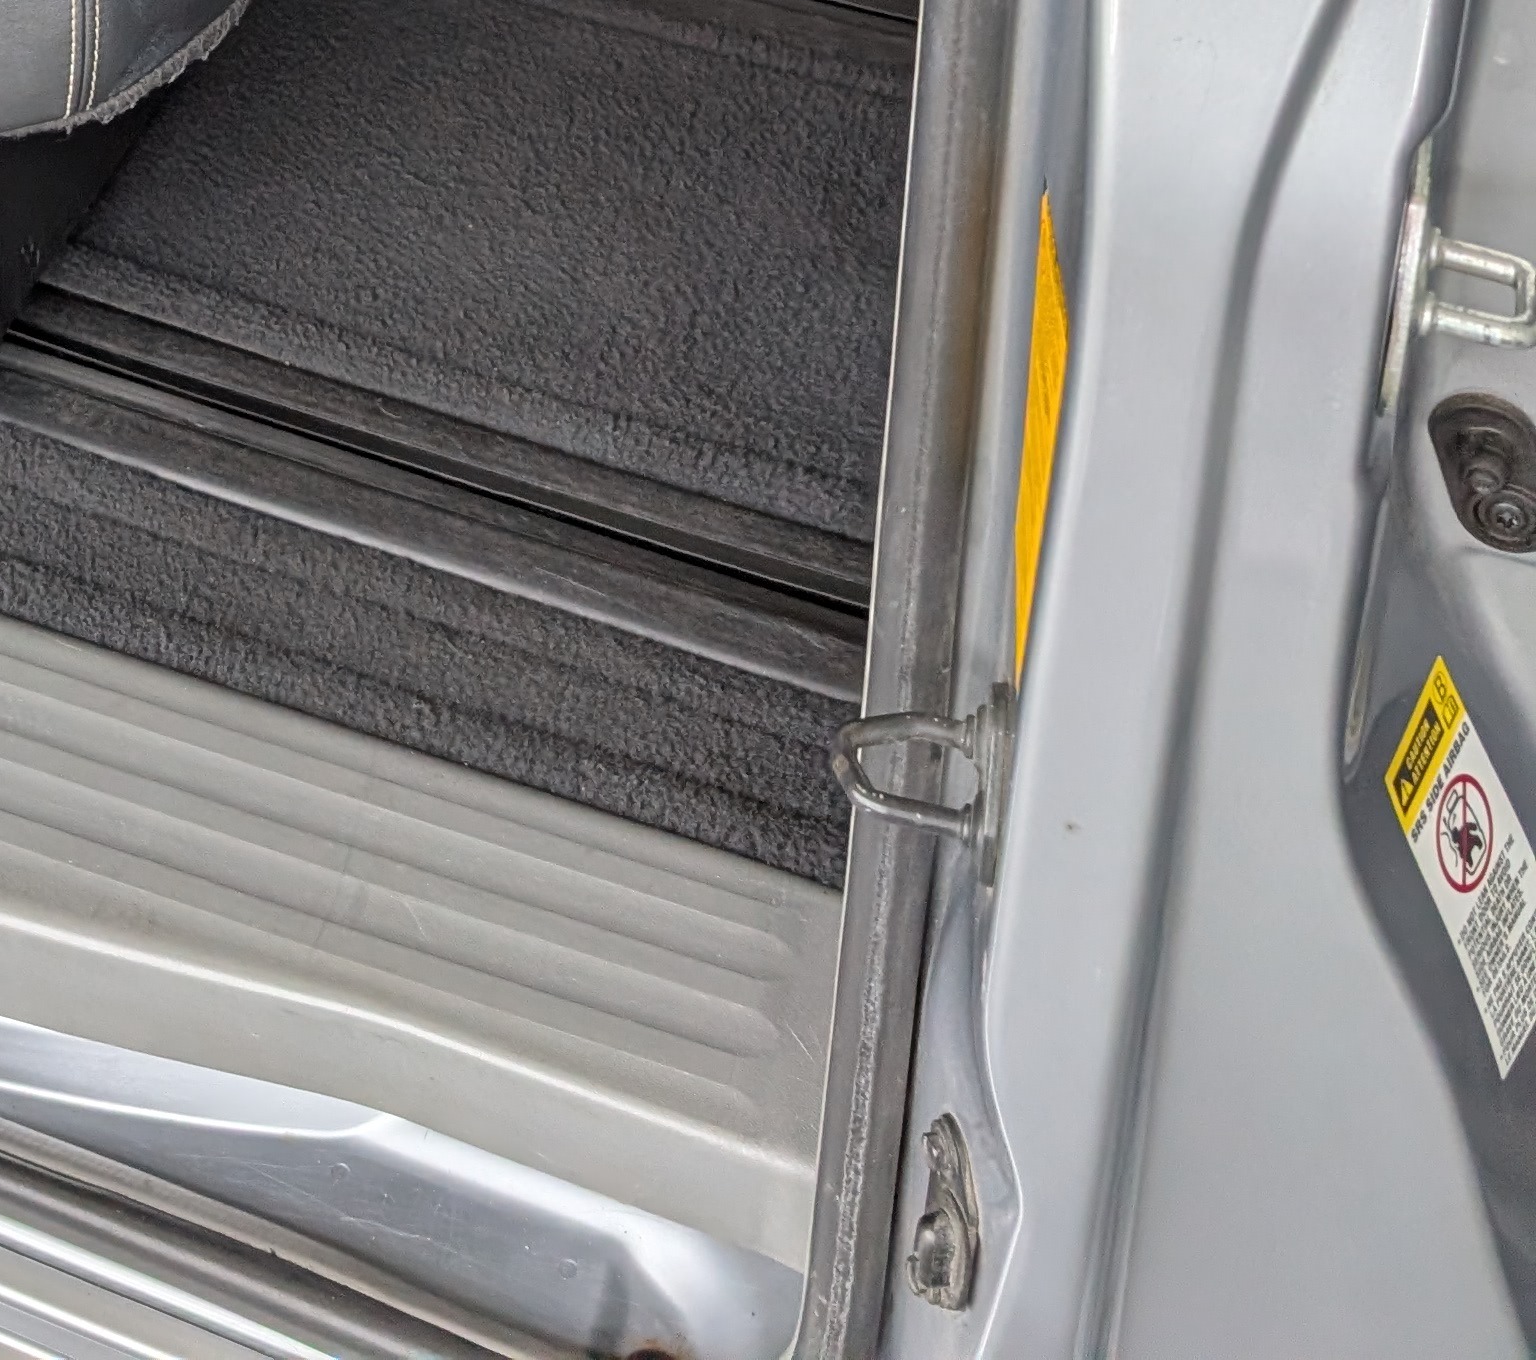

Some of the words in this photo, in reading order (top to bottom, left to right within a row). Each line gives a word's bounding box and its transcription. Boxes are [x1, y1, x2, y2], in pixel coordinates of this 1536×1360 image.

[1405, 718, 1431, 771] CAUTION
[1411, 720, 1442, 786] ATTENTION
[1411, 809, 1428, 844] SRS
[1425, 775, 1445, 813] SIDE
[1442, 720, 1471, 779] AIRBAG
